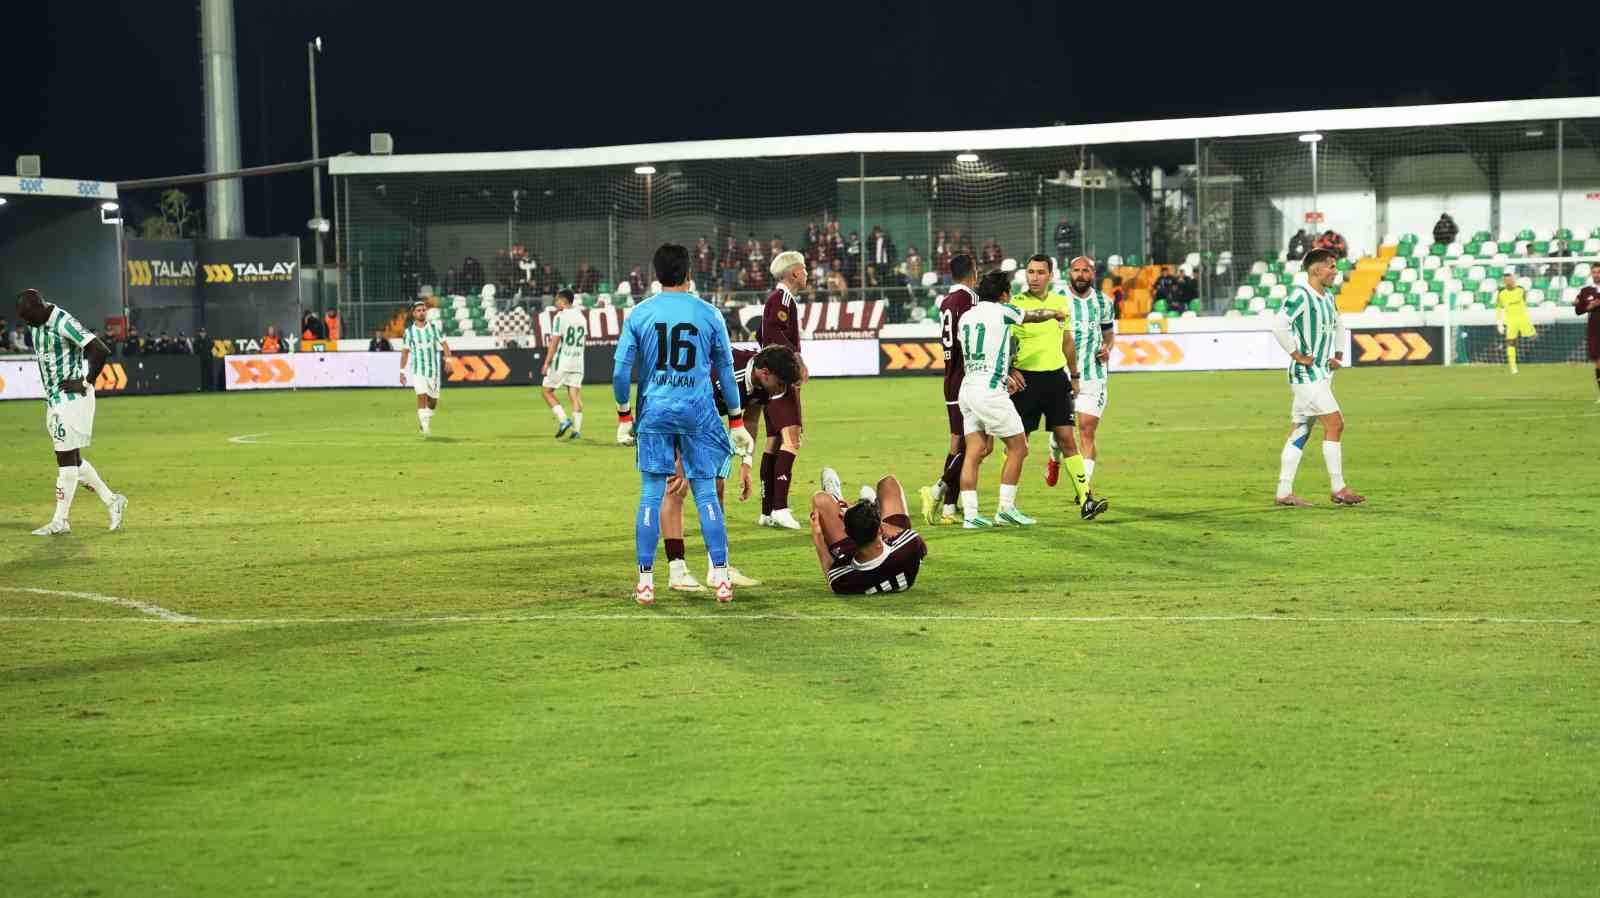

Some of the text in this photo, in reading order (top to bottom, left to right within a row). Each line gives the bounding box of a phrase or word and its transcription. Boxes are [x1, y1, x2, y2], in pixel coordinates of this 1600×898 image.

[152, 260, 198, 277] TALAY
[234, 262, 296, 275] TALAY
[235, 338, 298, 352] TAY
[565, 326, 585, 347] 82
[963, 323, 985, 360] 11
[655, 323, 698, 372] 16
